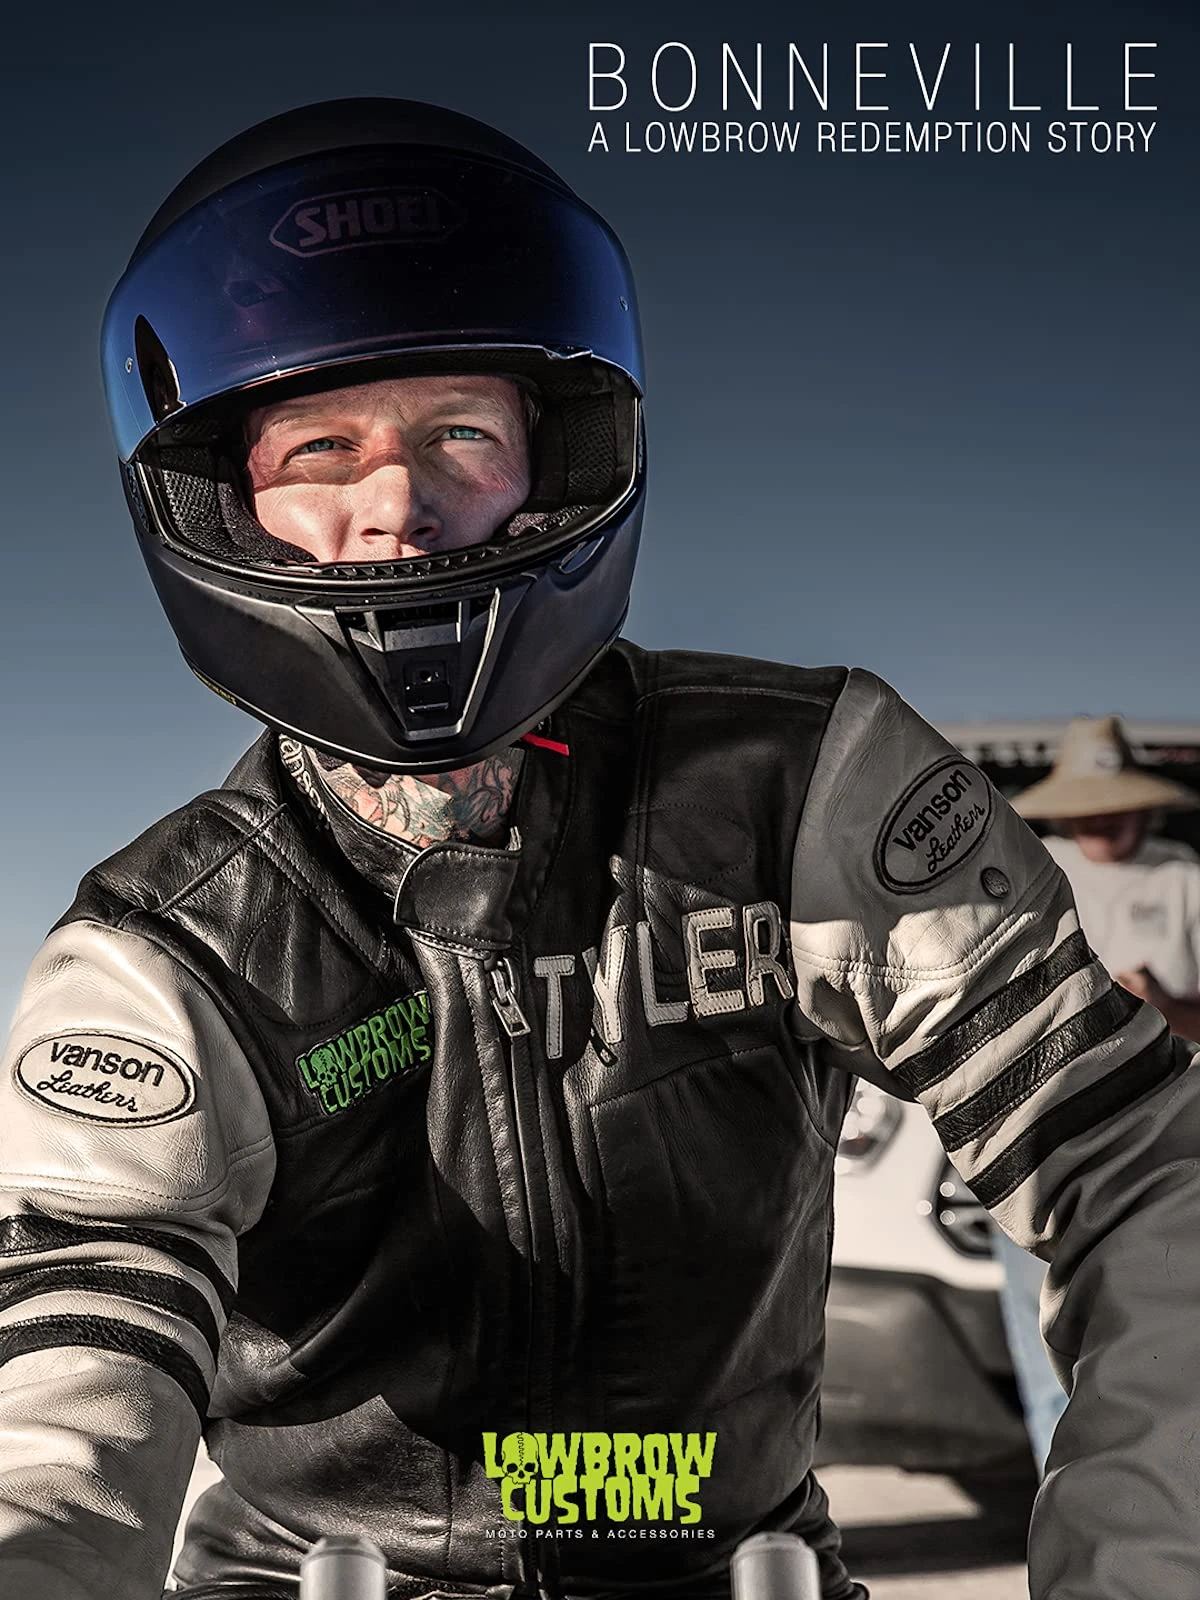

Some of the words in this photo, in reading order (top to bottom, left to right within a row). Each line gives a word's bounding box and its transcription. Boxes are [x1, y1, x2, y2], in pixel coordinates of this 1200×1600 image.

[293, 194, 441, 248] SHOEI
[892, 769, 972, 852] vanson
[926, 803, 985, 874] Leathers
[533, 900, 794, 1060] TYLER
[50, 1041, 165, 1087] vanson
[299, 993, 430, 1089] LOWBROW
[320, 1025, 431, 1113] CUSTOMS
[36, 1069, 138, 1112] Leathers
